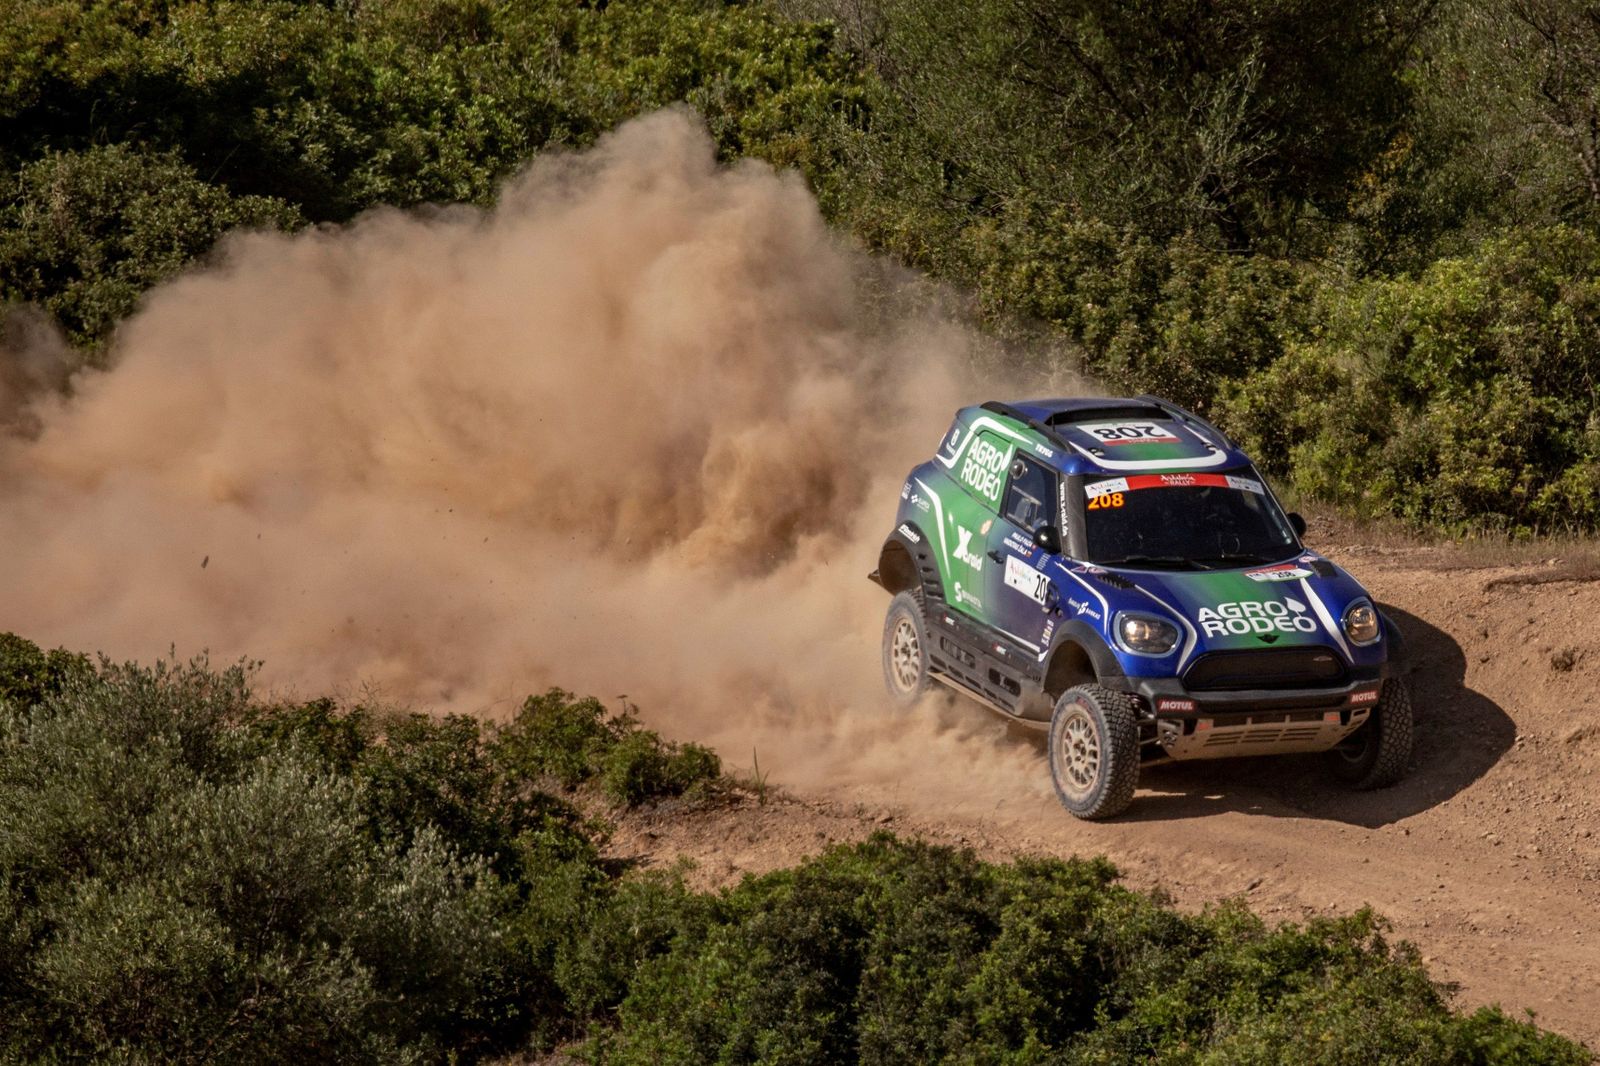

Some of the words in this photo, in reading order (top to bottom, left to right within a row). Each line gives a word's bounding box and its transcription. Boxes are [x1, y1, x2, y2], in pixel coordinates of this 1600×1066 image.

[1093, 425, 1166, 440] 208
[967, 436, 1001, 474] AGRO
[960, 457, 1002, 501] RODEO
[1087, 492, 1125, 510] 208
[1034, 574, 1047, 602] 20
[1198, 600, 1289, 623] AGRO
[1200, 616, 1317, 638] RODEO
[1160, 700, 1193, 711] MOTUL
[1351, 691, 1377, 702] MOTUL
